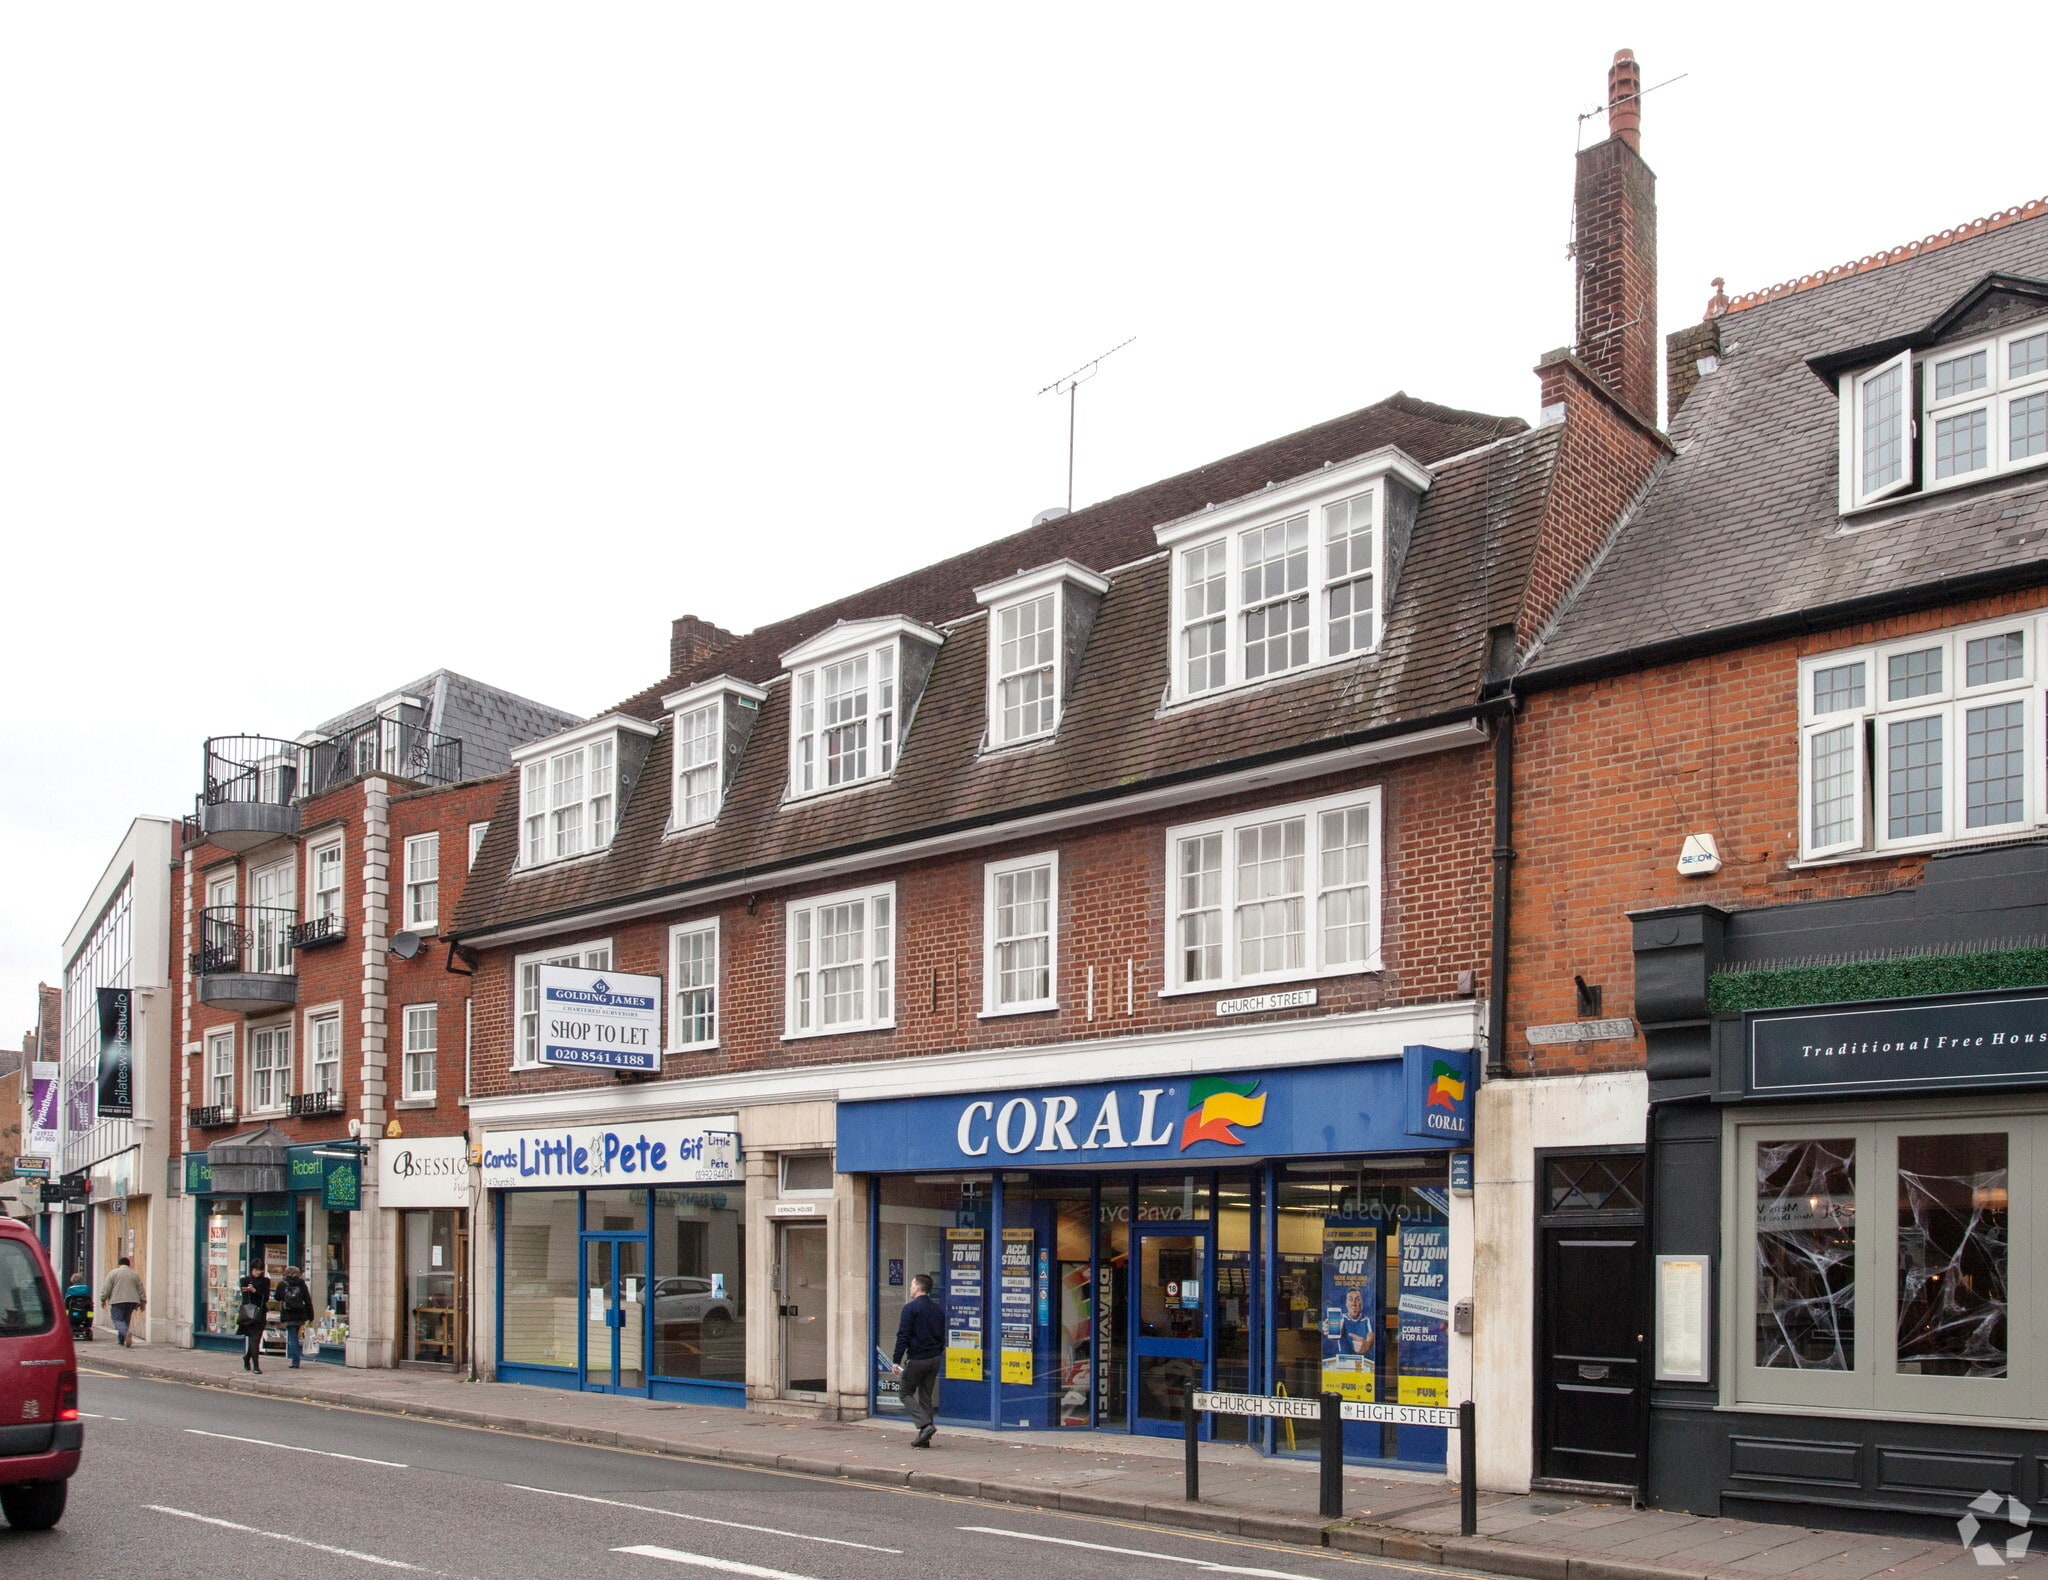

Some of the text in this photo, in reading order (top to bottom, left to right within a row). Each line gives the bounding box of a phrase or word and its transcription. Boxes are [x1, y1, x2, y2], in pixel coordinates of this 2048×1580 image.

[1682, 853, 1712, 864] SECOM
[596, 982, 606, 992] GJ
[555, 990, 646, 1006] GOLDING JAMES
[1220, 990, 1312, 1014] CHURCH STREET
[563, 1006, 639, 1018] CHARTERED SURVEYORS
[551, 1020, 649, 1046] SHOP TO LET
[115, 993, 131, 1104] pilatesworksstudio
[1802, 1032, 2047, 1057] Traditional Free Hous
[555, 1049, 645, 1066] 020 8541 4188
[32, 1079, 58, 1131] Physiotherapy
[957, 1089, 1174, 1156] CORAL
[1427, 1113, 1466, 1131] CORAL
[708, 1136, 731, 1147] Little
[483, 1147, 518, 1169] Cards
[520, 1134, 589, 1177] Little
[604, 1132, 668, 1173] Pete
[292, 1158, 319, 1175] Robert
[710, 1159, 729, 1169] Pete
[797, 1205, 813, 1213] HOUSE
[210, 1226, 227, 1239] NEW
[1403, 1232, 1441, 1246] WANT
[1005, 1244, 1027, 1255] ACCA
[1333, 1245, 1369, 1260] CASH
[1403, 1246, 1448, 1260] TO JOIN
[952, 1251, 981, 1262] TO WIN
[1002, 1254, 1031, 1266] STACKA
[1338, 1259, 1365, 1275] OUT
[1402, 1260, 1431, 1273] OUR
[1403, 1274, 1444, 1287] TEAM?
[1168, 1284, 1177, 1293] 18
[1402, 1301, 1429, 1313] MANAGER'S
[1401, 1325, 1429, 1334] COME IN
[1402, 1334, 1415, 1342] FOR
[881, 1382, 891, 1391] BT
[1341, 1383, 1356, 1391] FUN
[1416, 1387, 1436, 1398] FUN
[1210, 1395, 1317, 1417] CHURCH STREET
[1356, 1404, 1456, 1425] HIGH STREET
